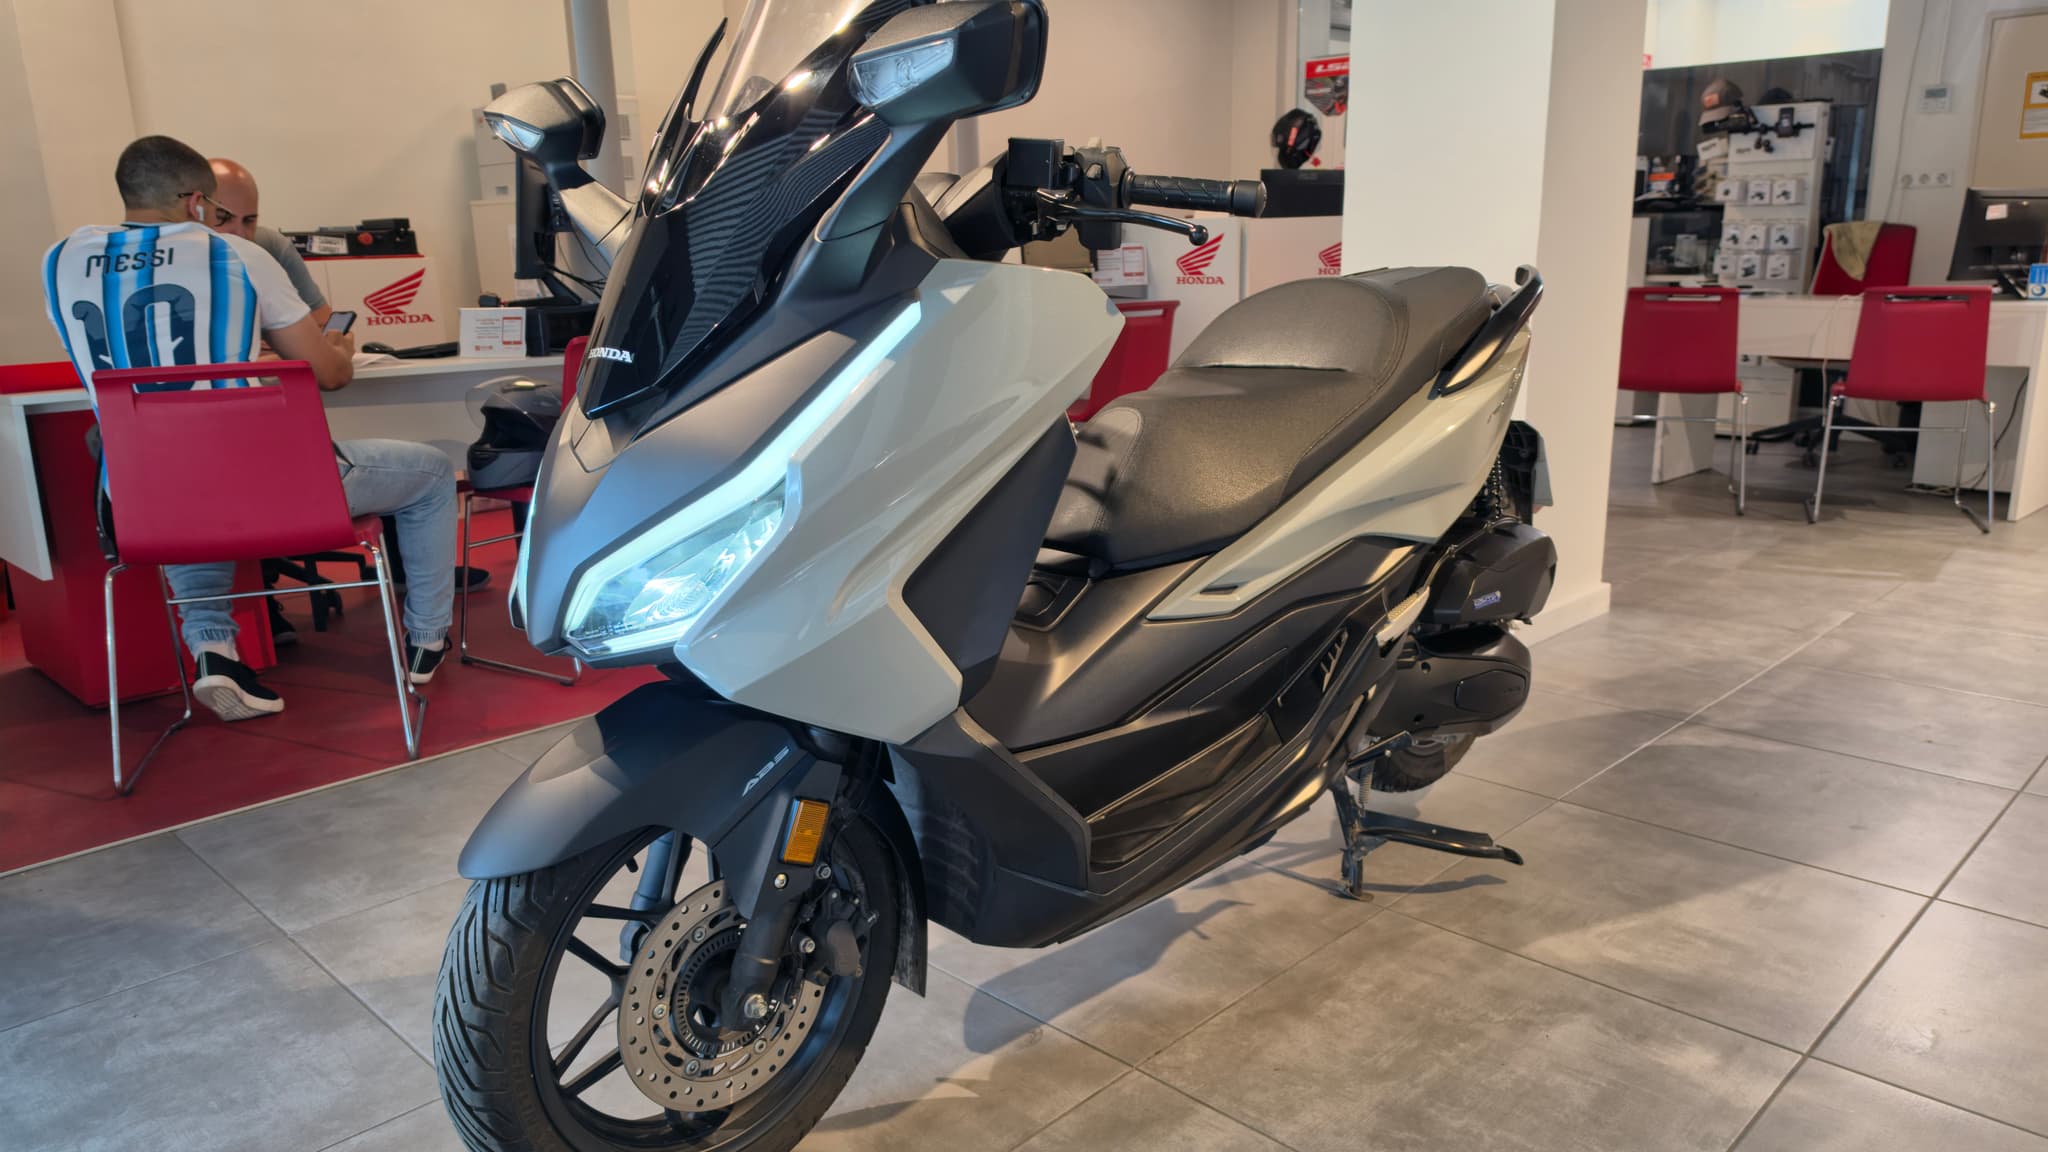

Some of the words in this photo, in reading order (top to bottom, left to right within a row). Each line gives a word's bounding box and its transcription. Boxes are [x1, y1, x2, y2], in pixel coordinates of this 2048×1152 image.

[86, 248, 174, 278] MESSI
[1176, 276, 1225, 285] HONDA
[366, 313, 434, 327] HONDA
[72, 283, 195, 390] 10
